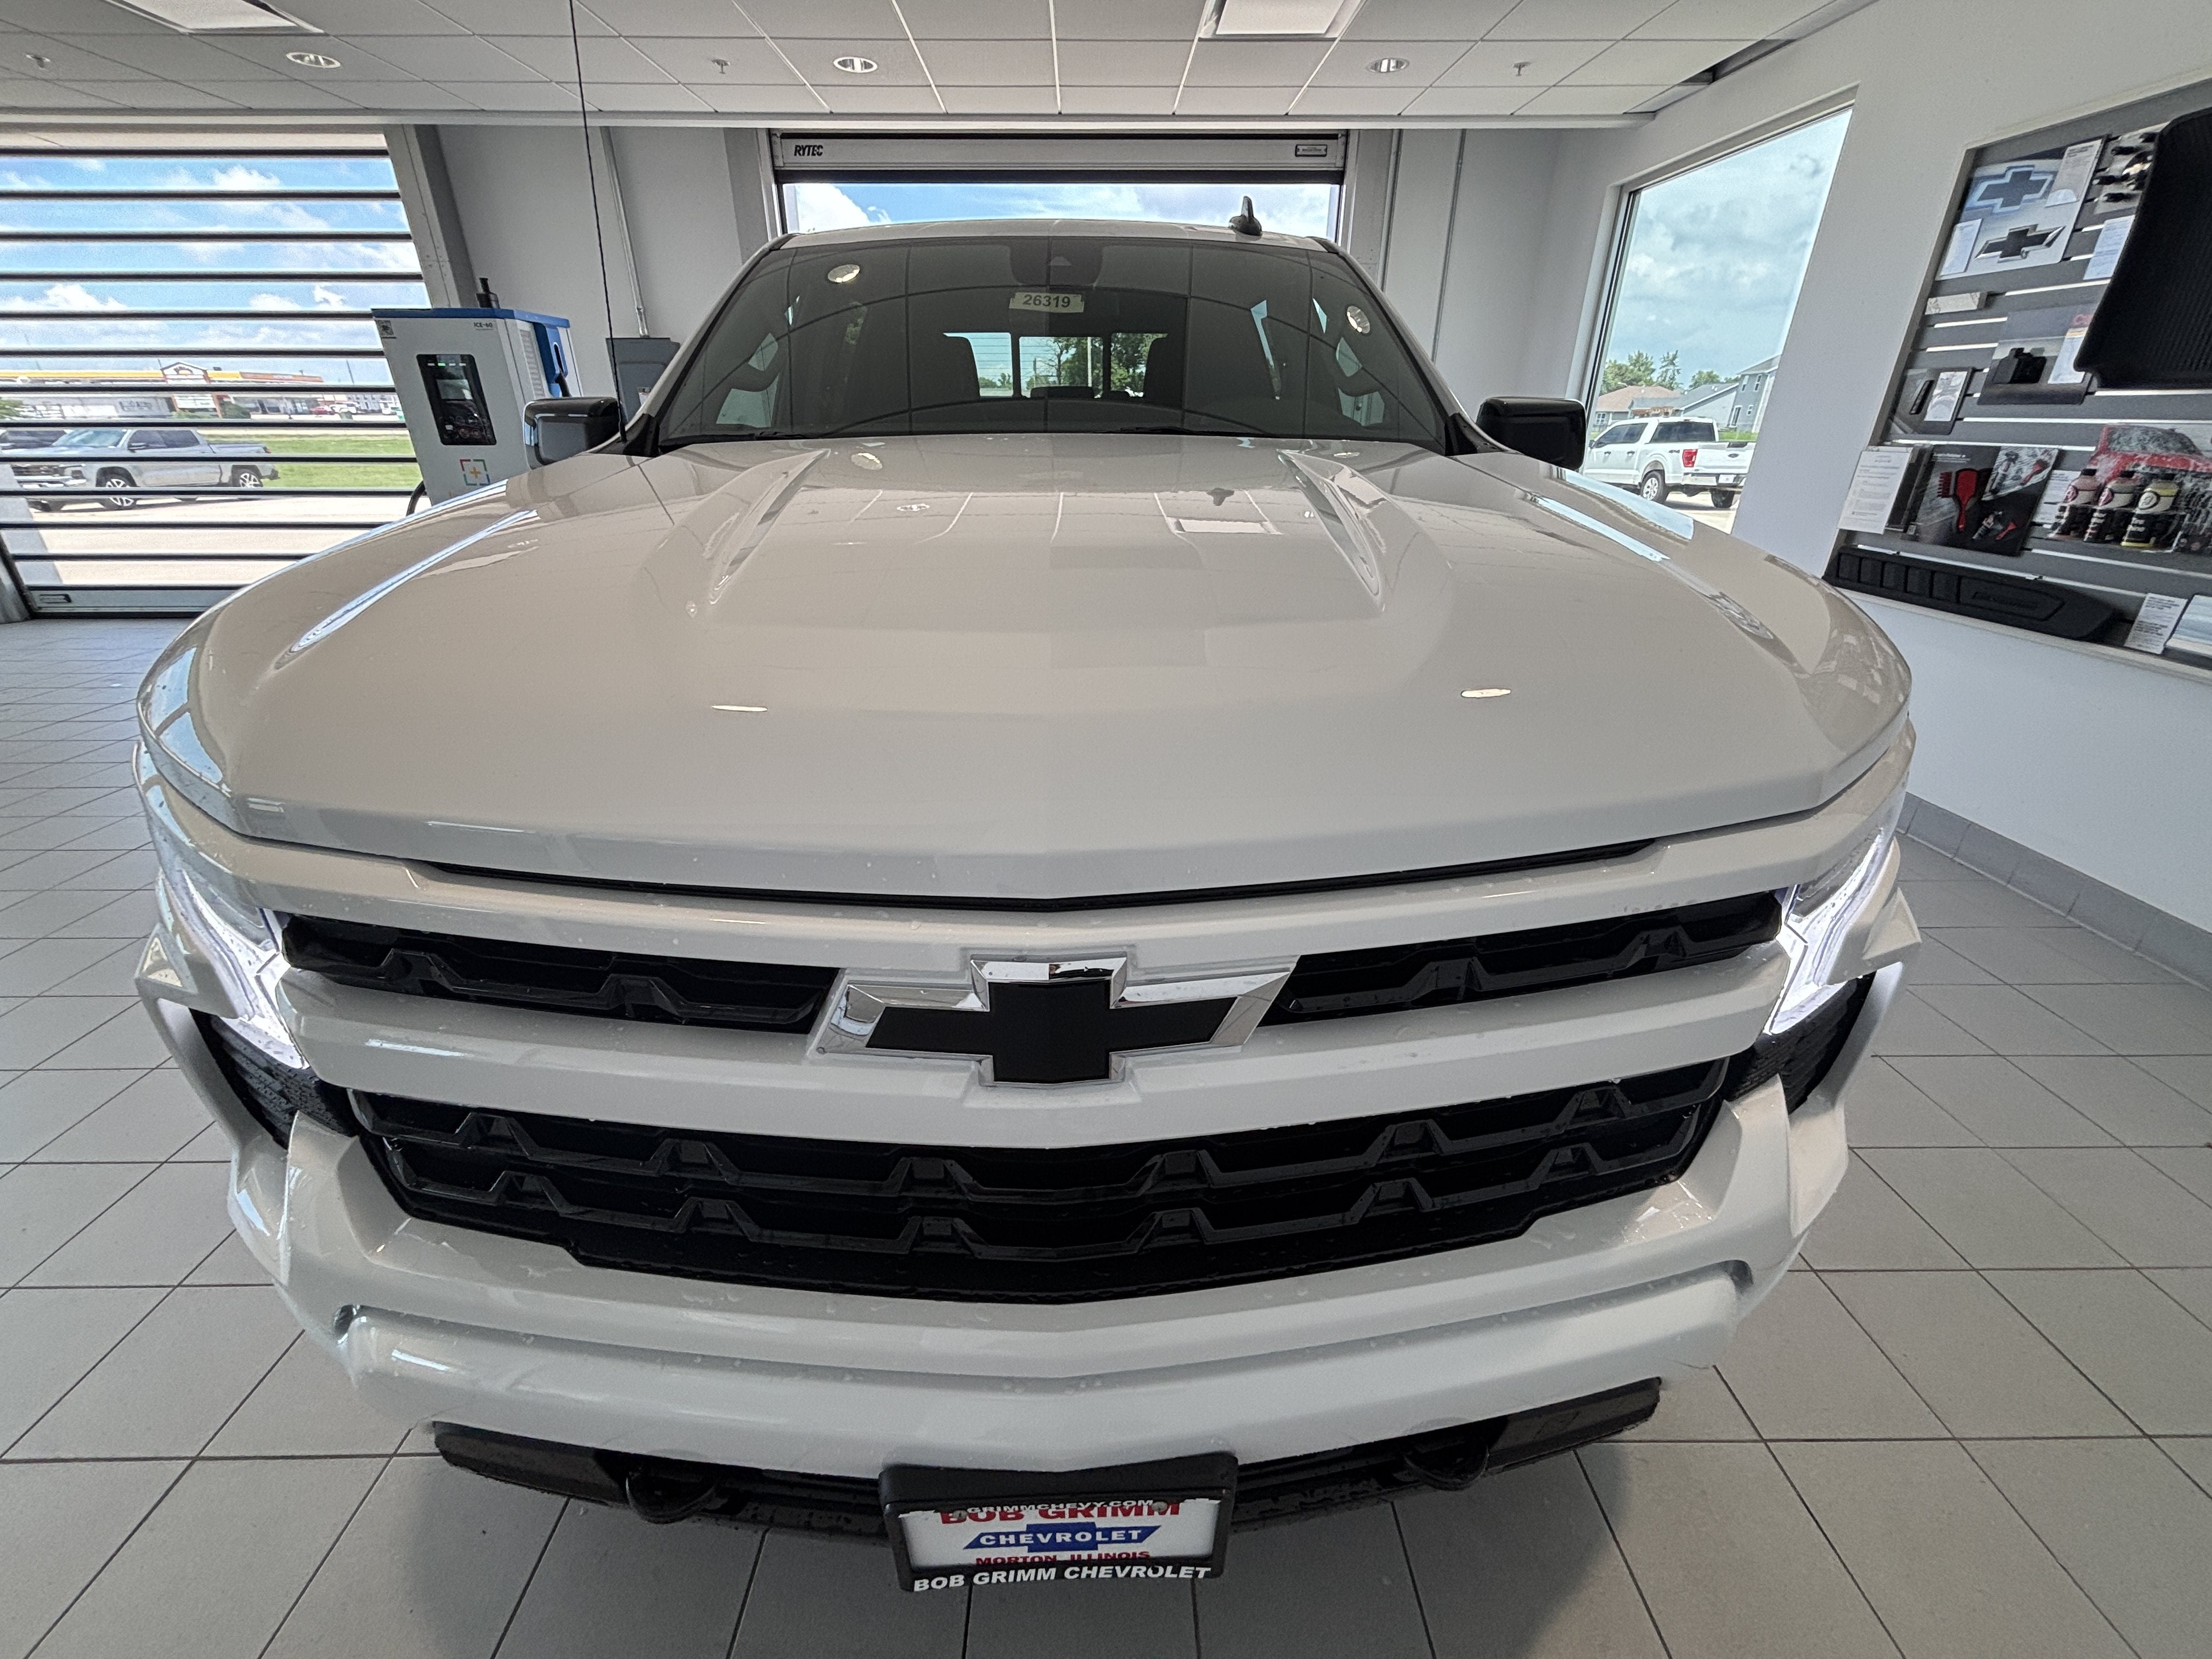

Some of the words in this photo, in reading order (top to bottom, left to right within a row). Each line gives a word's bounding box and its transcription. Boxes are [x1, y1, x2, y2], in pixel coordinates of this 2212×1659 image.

[794, 145, 823, 156] RYTEC
[1023, 294, 1071, 307] 26319
[967, 1499, 1154, 1514] GRIMMCHEVY.COM
[980, 1530, 1142, 1545] CHEVROLET
[975, 1554, 1057, 1565] MORTON
[1070, 1551, 1151, 1561] ILLINOIS
[913, 1574, 965, 1592] BOB
[973, 1567, 1057, 1585] GRIMM
[1064, 1565, 1211, 1579] CHEVROLET
